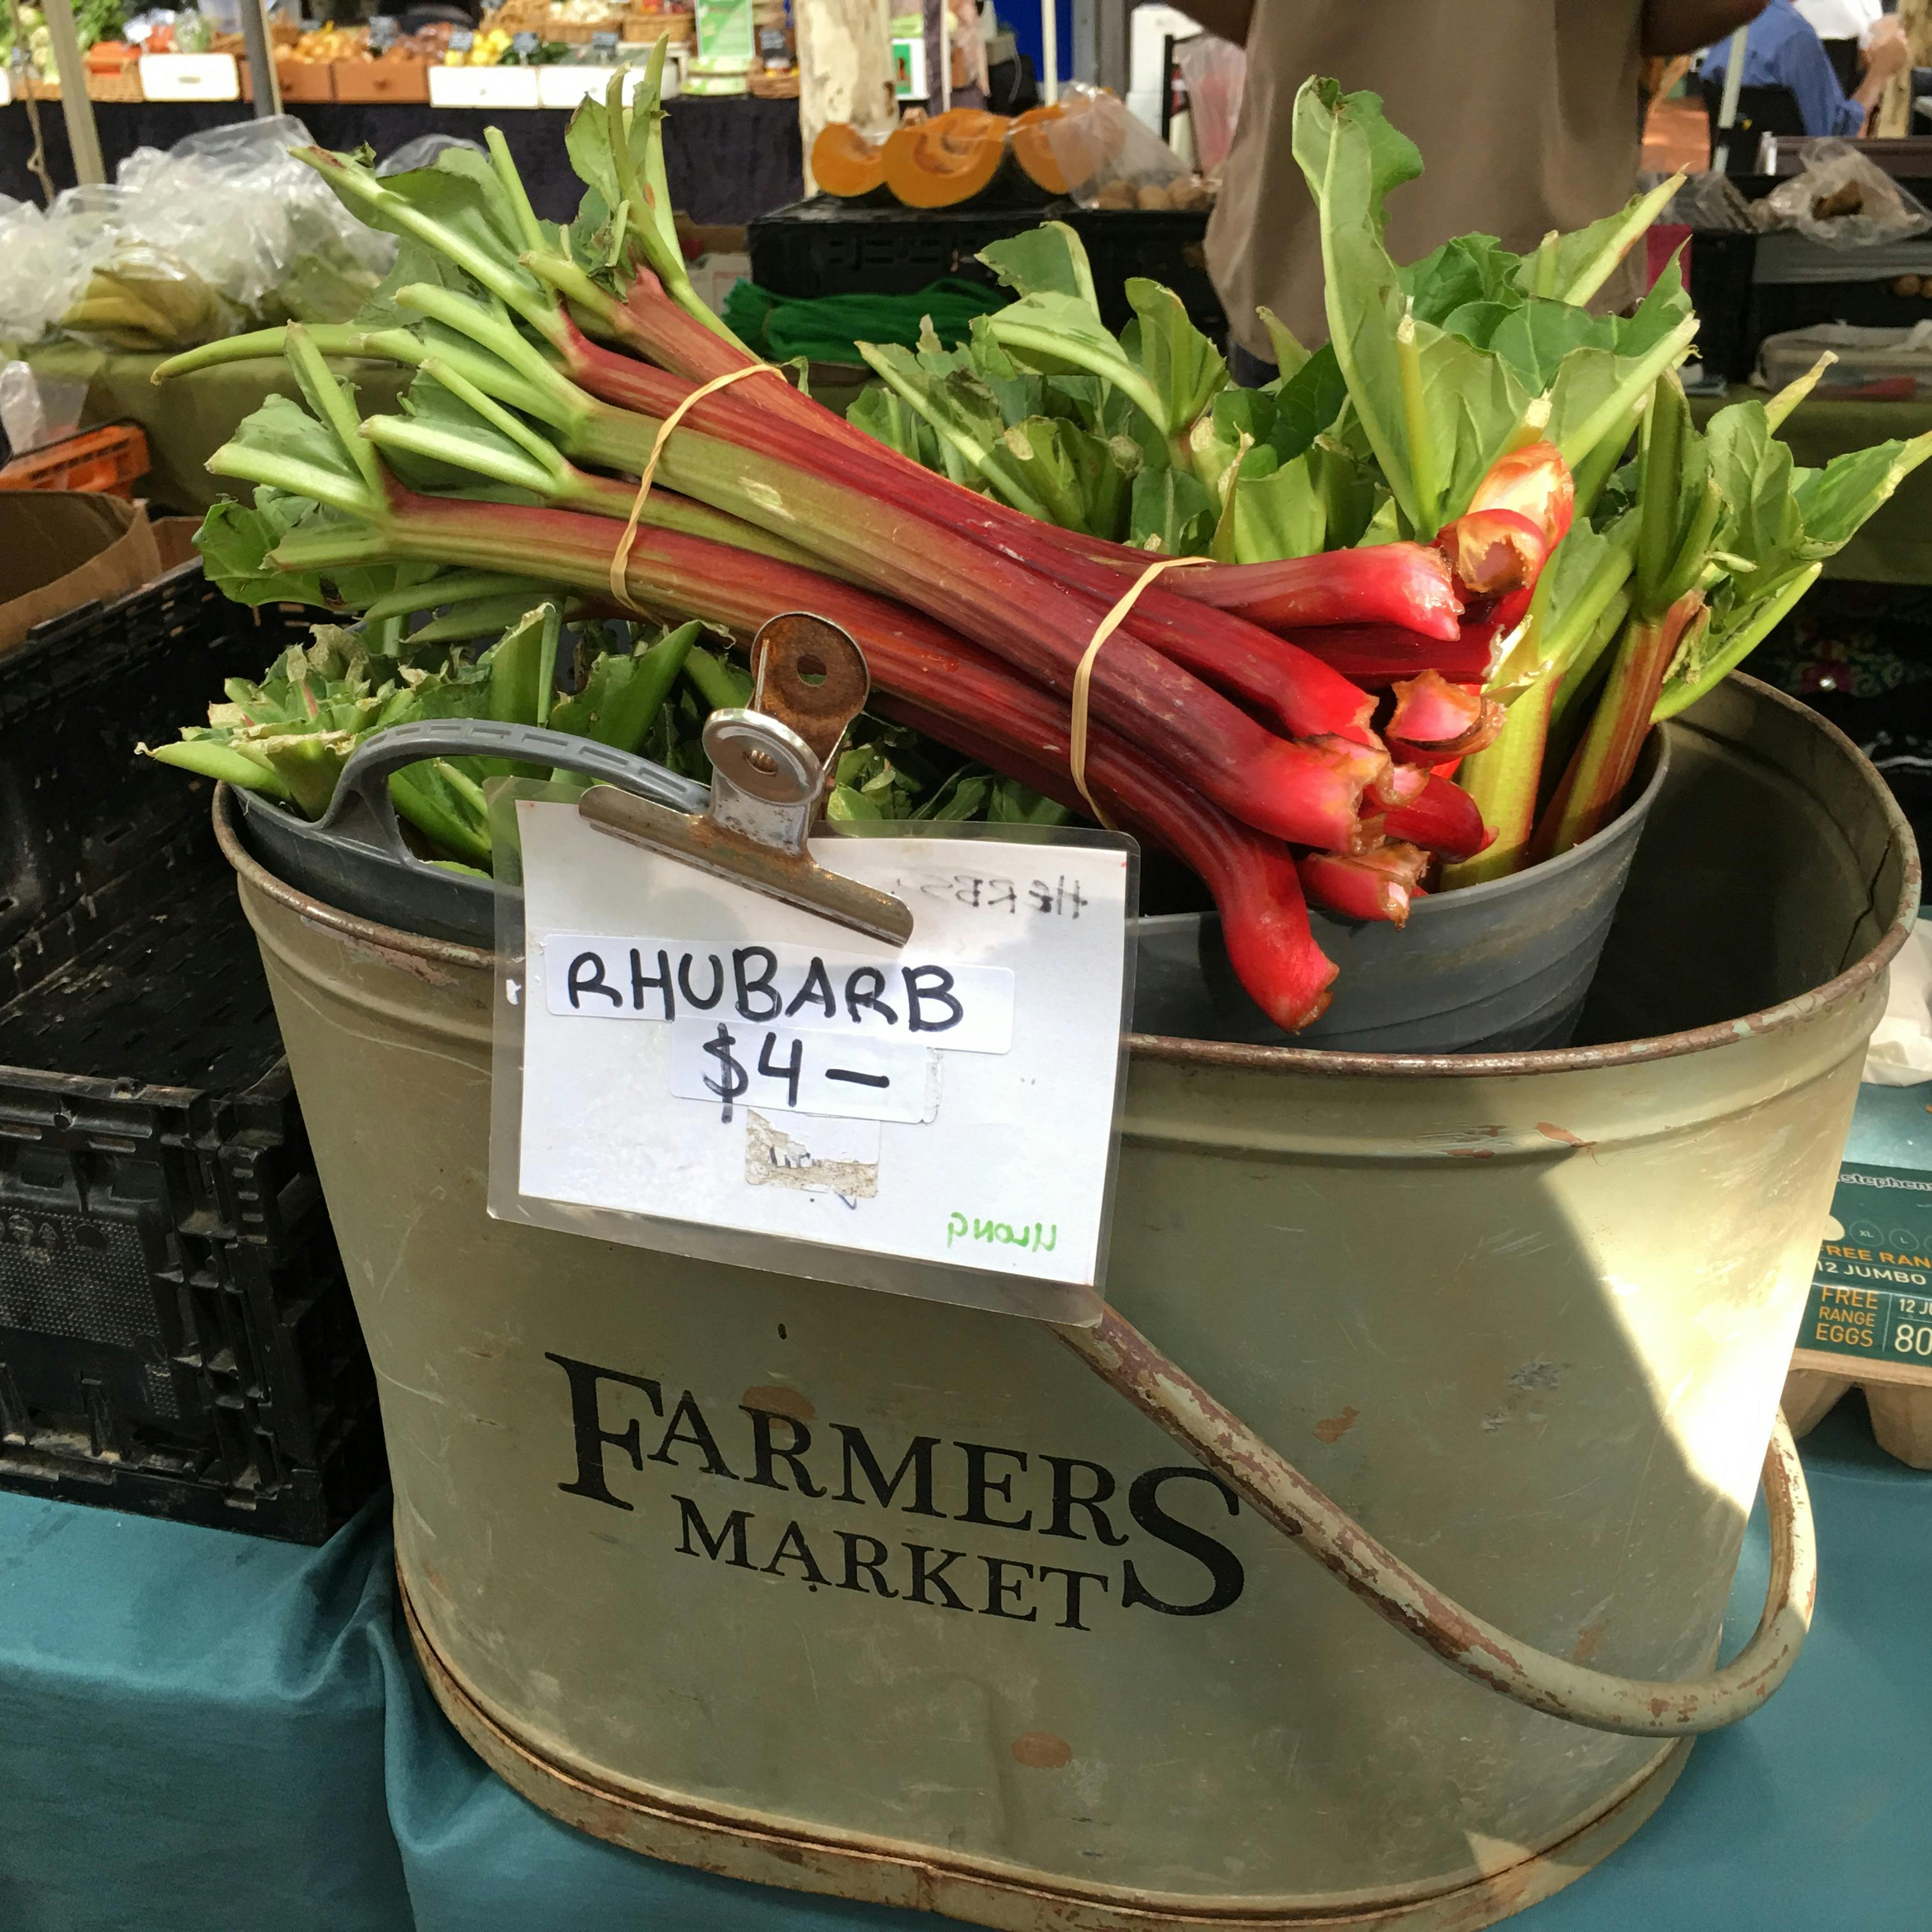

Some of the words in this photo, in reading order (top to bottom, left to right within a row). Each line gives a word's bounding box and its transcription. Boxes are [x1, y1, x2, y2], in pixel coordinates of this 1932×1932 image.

[567, 946, 964, 1032] RHUBARB
[1820, 1245, 1873, 1261] REE
[1843, 1264, 1927, 1285] JUMBO
[1821, 1285, 1880, 1310] FREE
[1899, 1298, 1915, 1314] 12
[1819, 1306, 1877, 1327] RANGE
[1816, 1322, 1874, 1347] EGGS
[544, 1351, 1245, 1618] FARMERS
[671, 1494, 1109, 1631] MARKET
